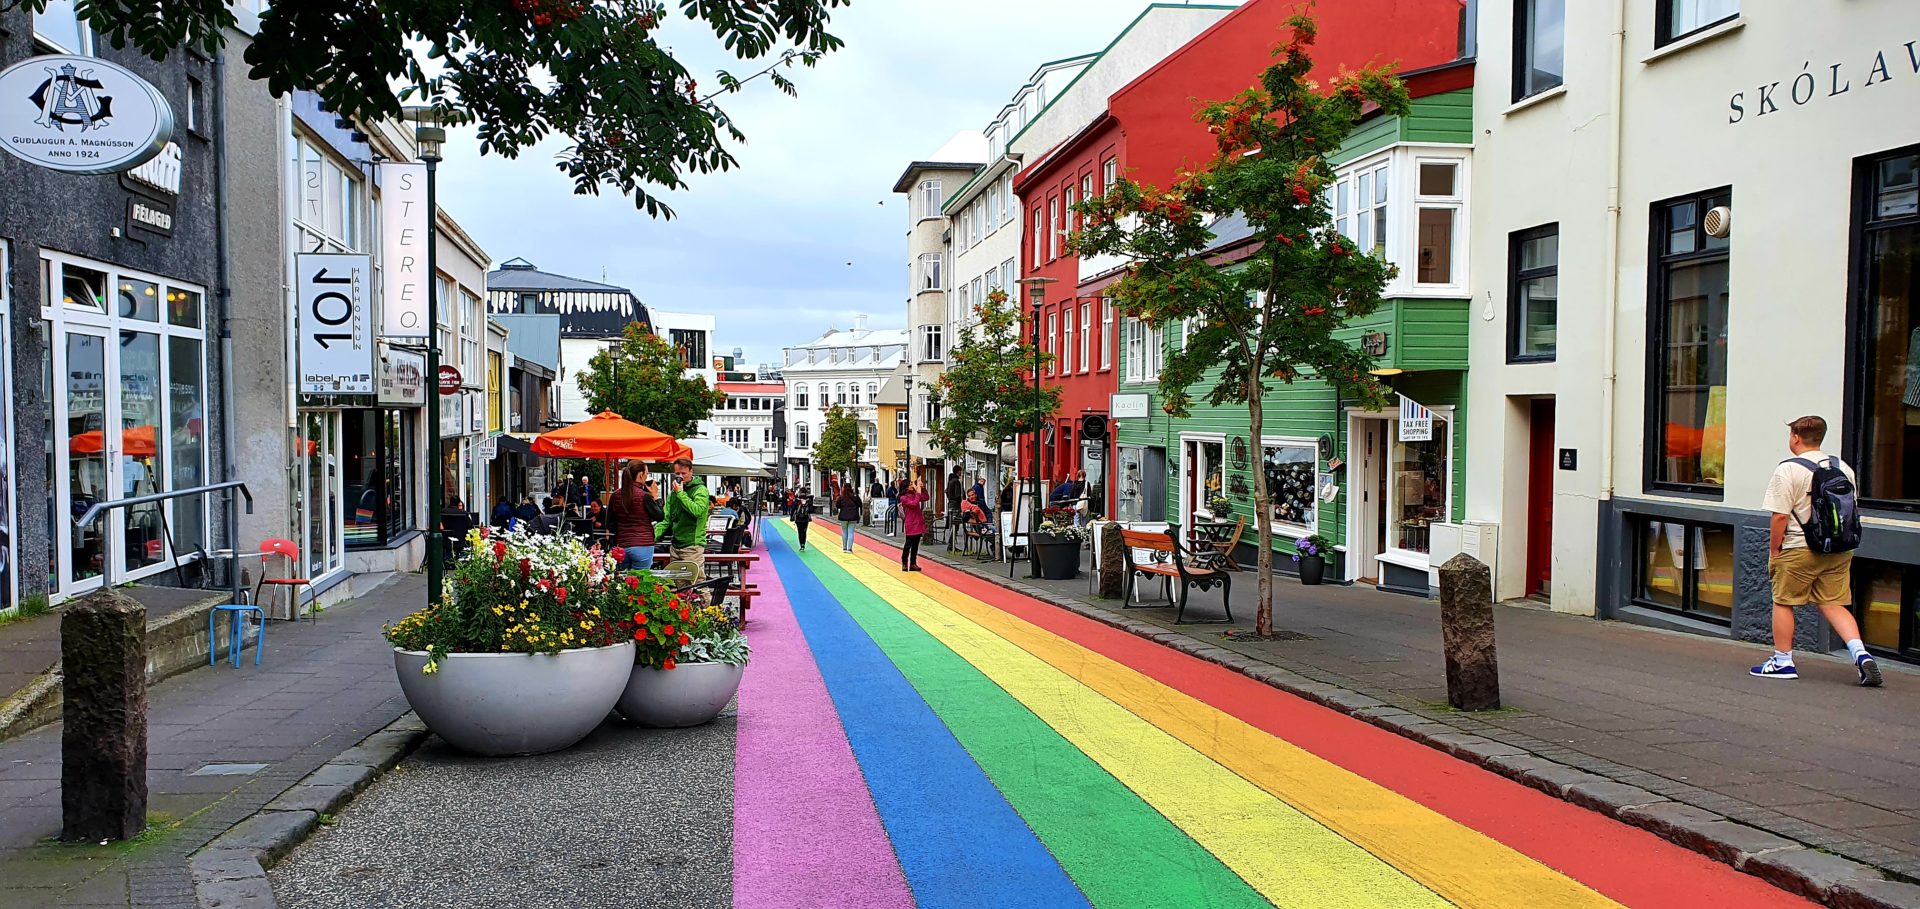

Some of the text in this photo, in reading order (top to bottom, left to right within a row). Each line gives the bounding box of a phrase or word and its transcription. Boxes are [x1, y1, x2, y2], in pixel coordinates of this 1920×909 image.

[12, 136, 65, 146] GUDLAUGUR
[81, 138, 134, 147] MAGNÚSSON
[75, 150, 100, 158] 1924
[312, 267, 353, 350] 101
